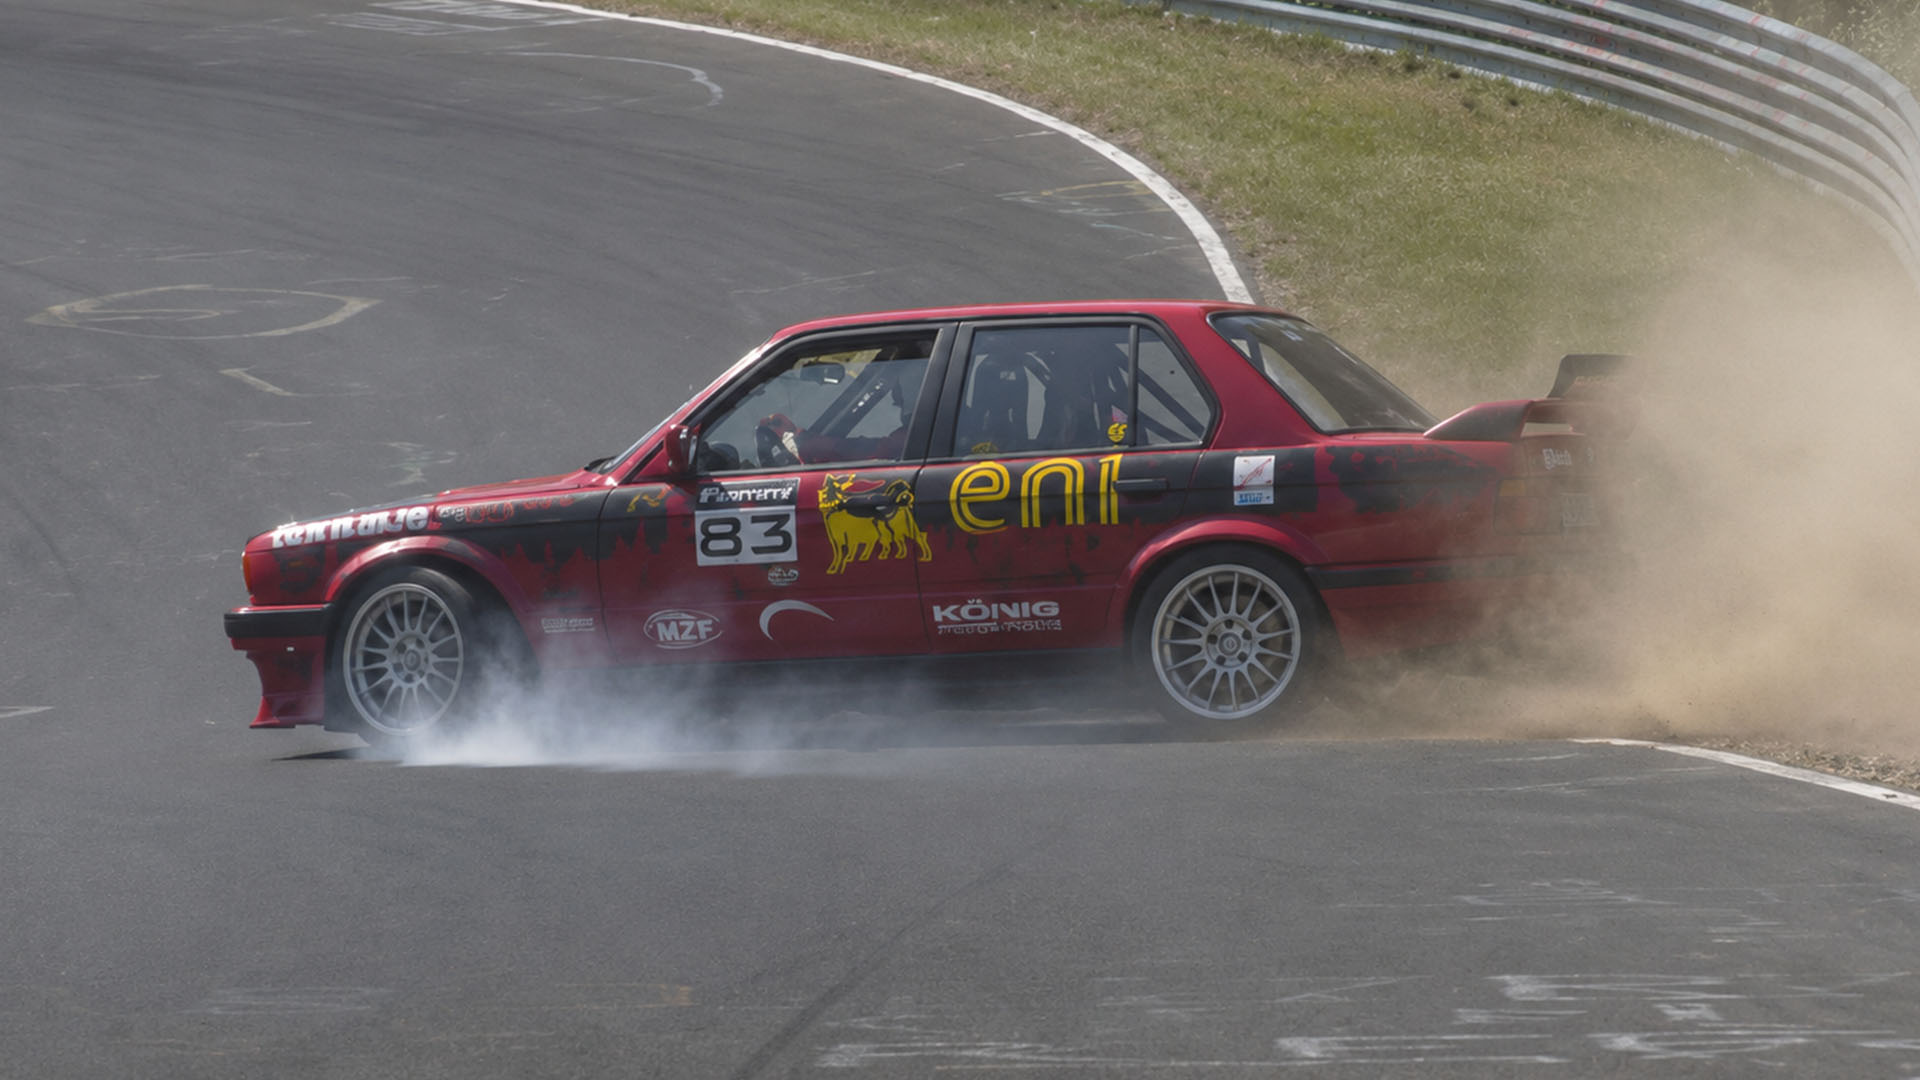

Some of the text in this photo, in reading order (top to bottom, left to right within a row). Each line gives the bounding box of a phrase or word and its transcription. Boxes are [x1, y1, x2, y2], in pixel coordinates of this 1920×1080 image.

[700, 513, 793, 557] 83
[932, 598, 1060, 622] KÖNIG
[657, 619, 713, 642] MZF
